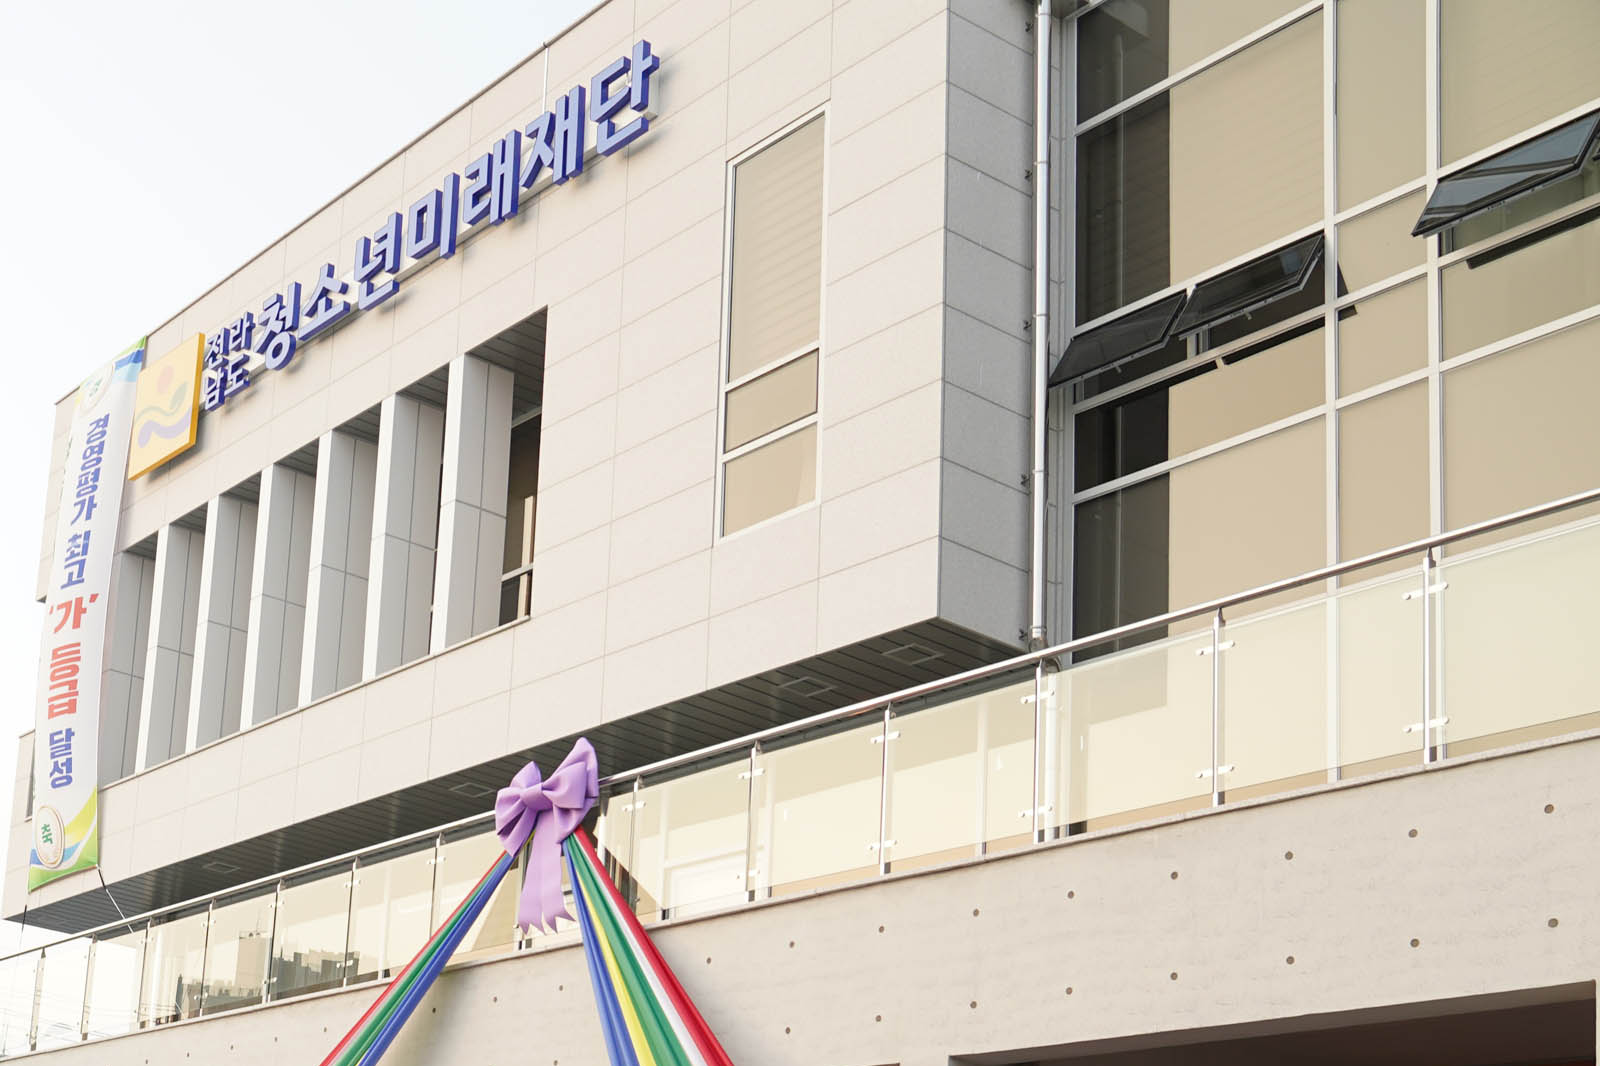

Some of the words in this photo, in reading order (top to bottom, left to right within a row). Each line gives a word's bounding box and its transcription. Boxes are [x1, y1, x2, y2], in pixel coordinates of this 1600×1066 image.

[253, 39, 660, 371] 청소년미래재단
[203, 311, 256, 369] 전라
[203, 353, 251, 411] 남도
[69, 412, 111, 526] 경영평가
[59, 529, 92, 590] 최고
[47, 641, 82, 721] 등급
[48, 727, 76, 790] 달성
